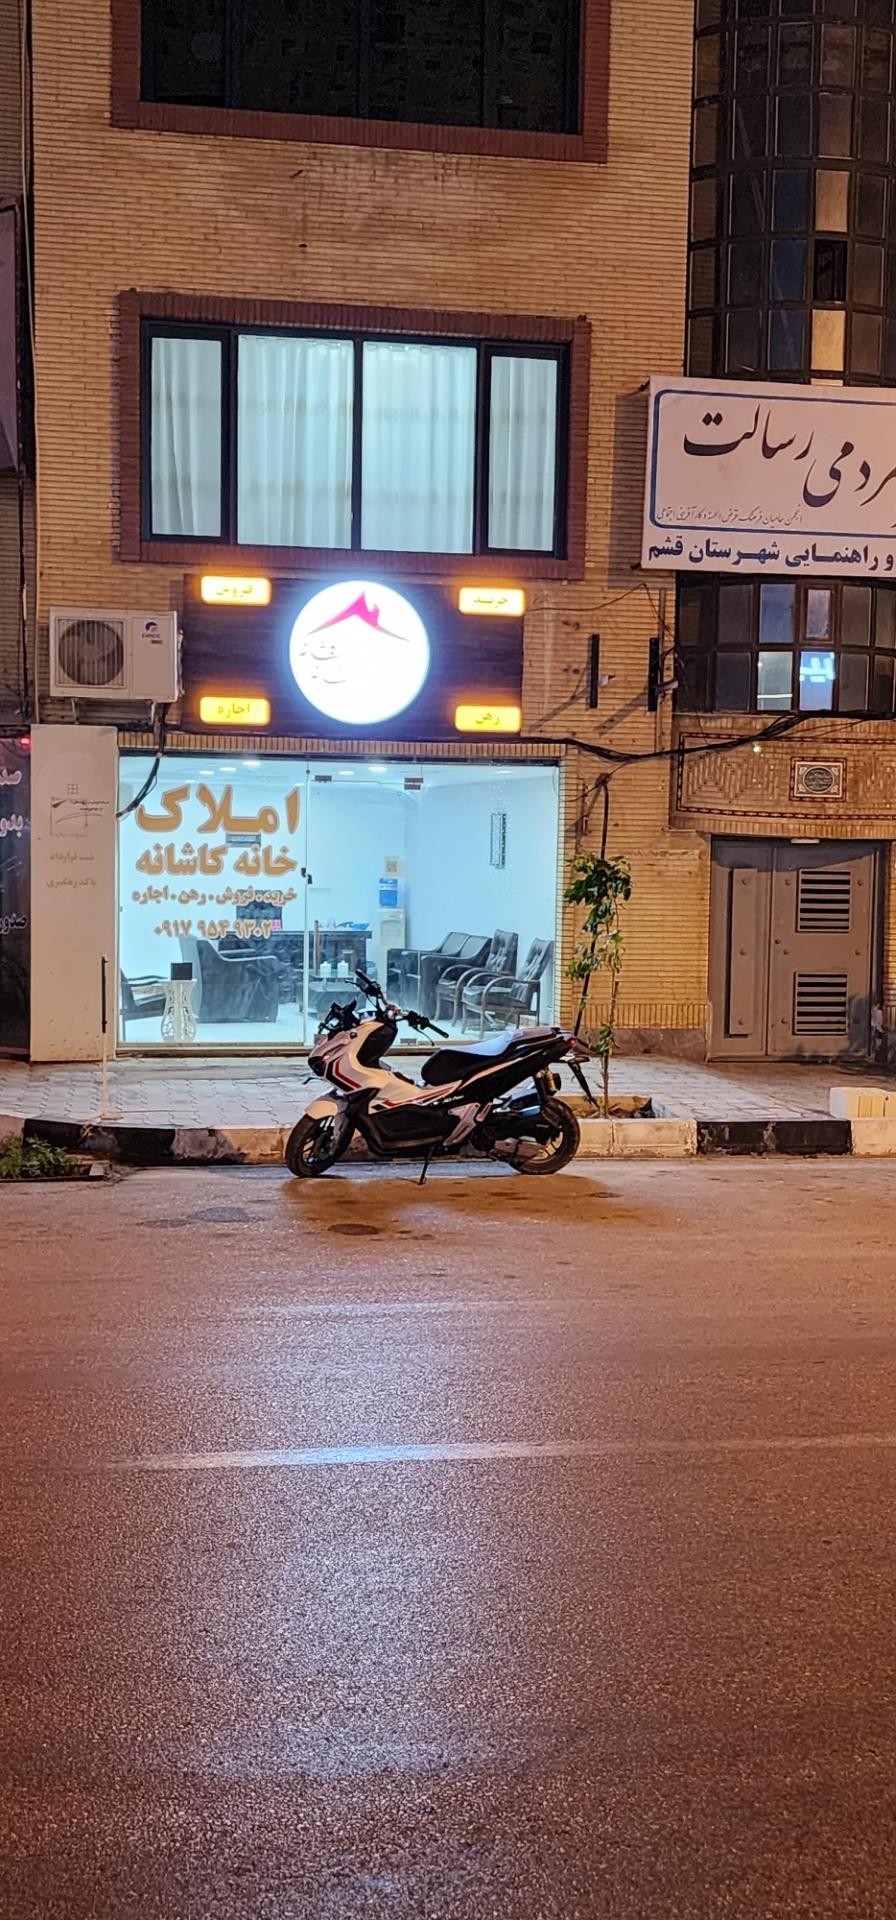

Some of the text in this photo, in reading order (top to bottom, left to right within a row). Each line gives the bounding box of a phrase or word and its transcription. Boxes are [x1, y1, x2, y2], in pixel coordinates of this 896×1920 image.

[683, 403, 815, 461] رسالت
[648, 535, 893, 571] و راهنمایی شهرستان قشم
[135, 783, 300, 834] املاک
[135, 843, 298, 876] خانه کاشانه
[131, 885, 298, 906] خرید فروش رهن اجاره
